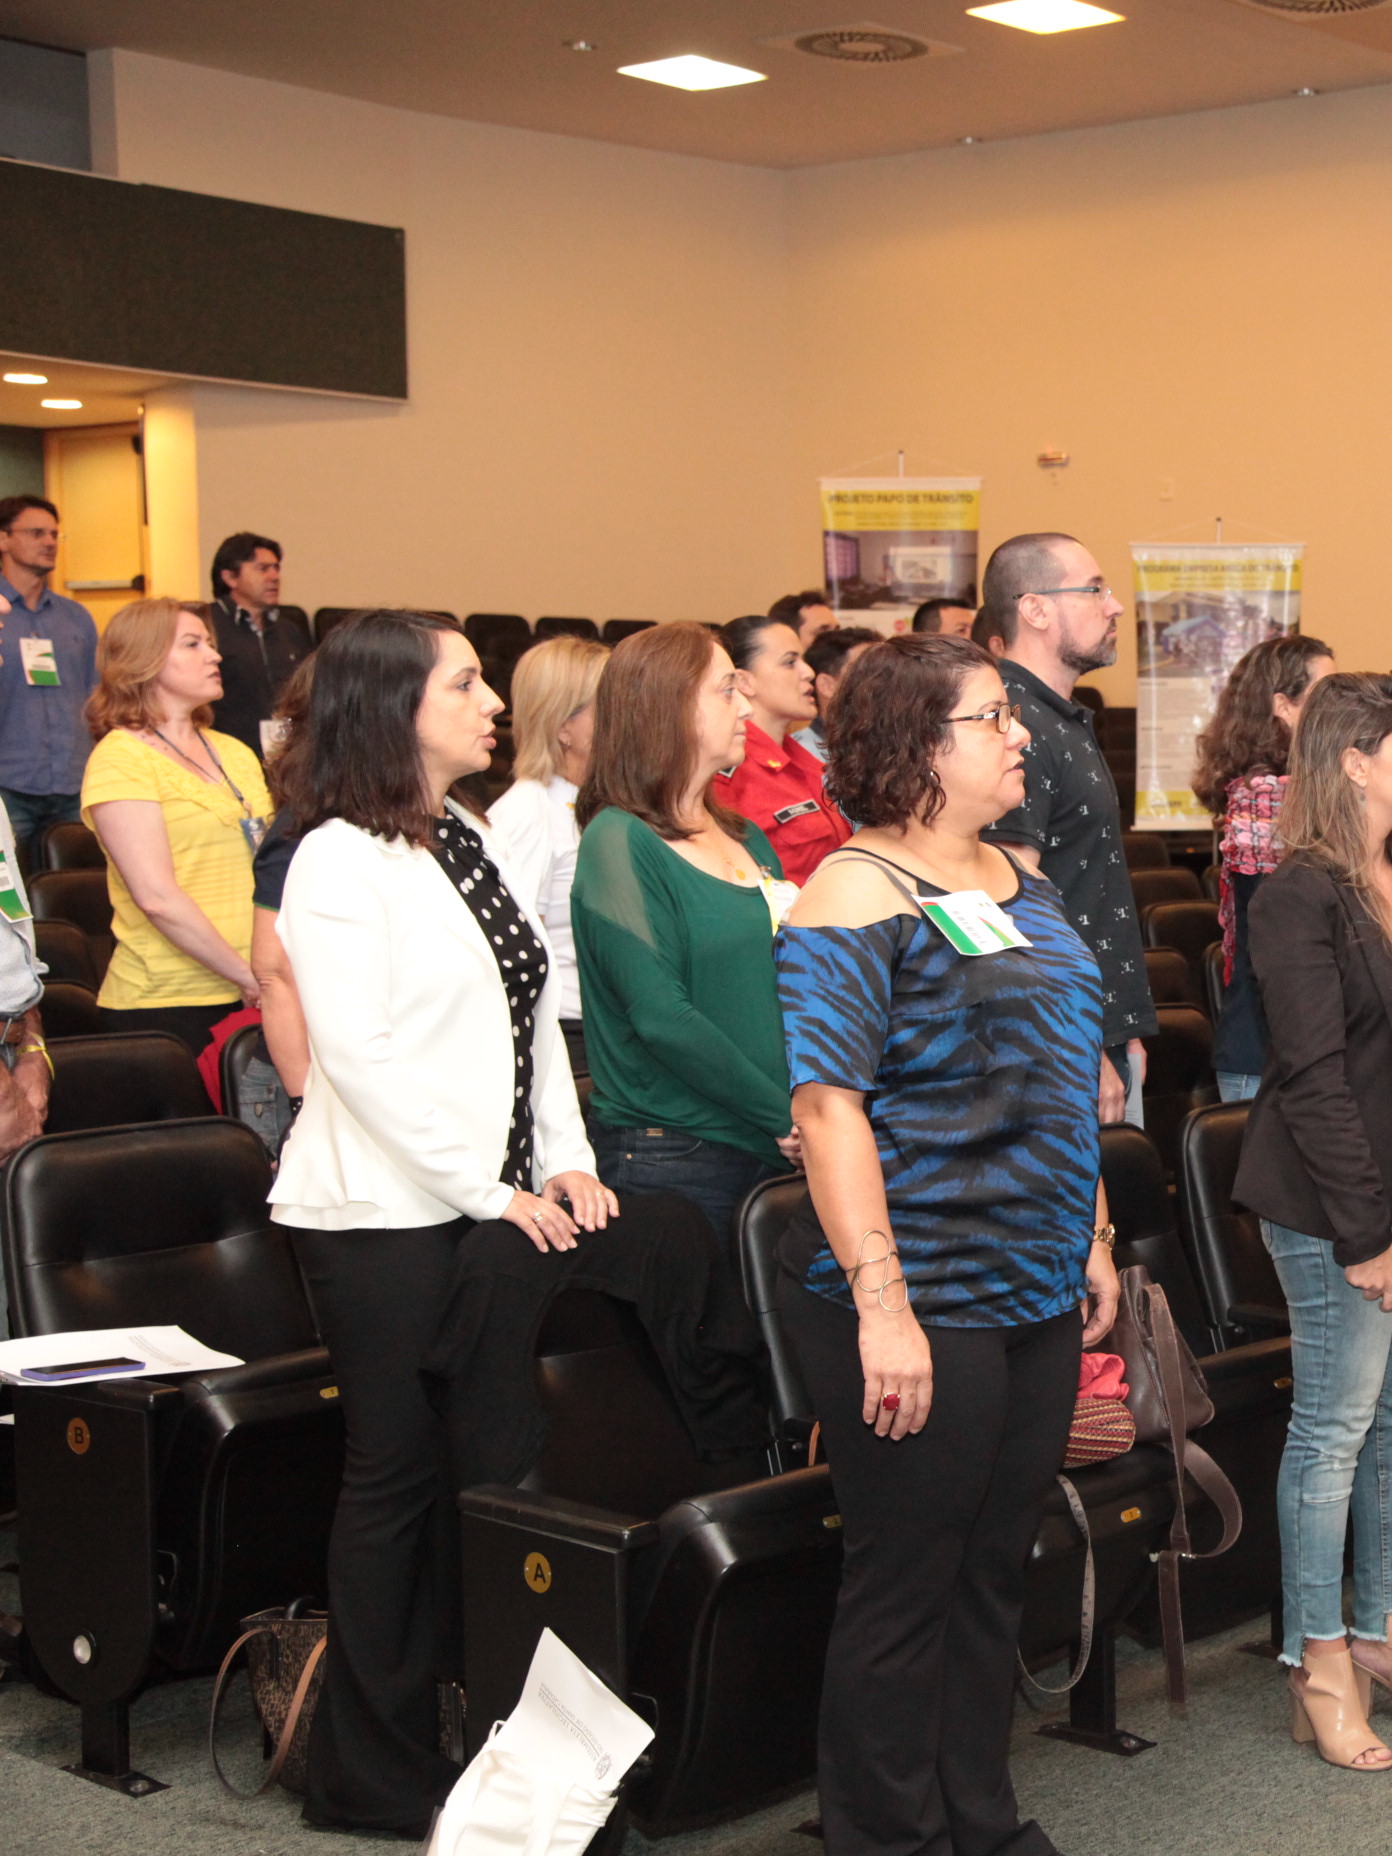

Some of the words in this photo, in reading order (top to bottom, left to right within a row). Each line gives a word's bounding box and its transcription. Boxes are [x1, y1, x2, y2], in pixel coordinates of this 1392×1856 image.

[877, 493, 904, 504] PAPO
[906, 493, 920, 504] DE
[922, 491, 975, 504] TRÂNSITO
[74, 1426, 84, 1444] B
[533, 1562, 547, 1584] A
